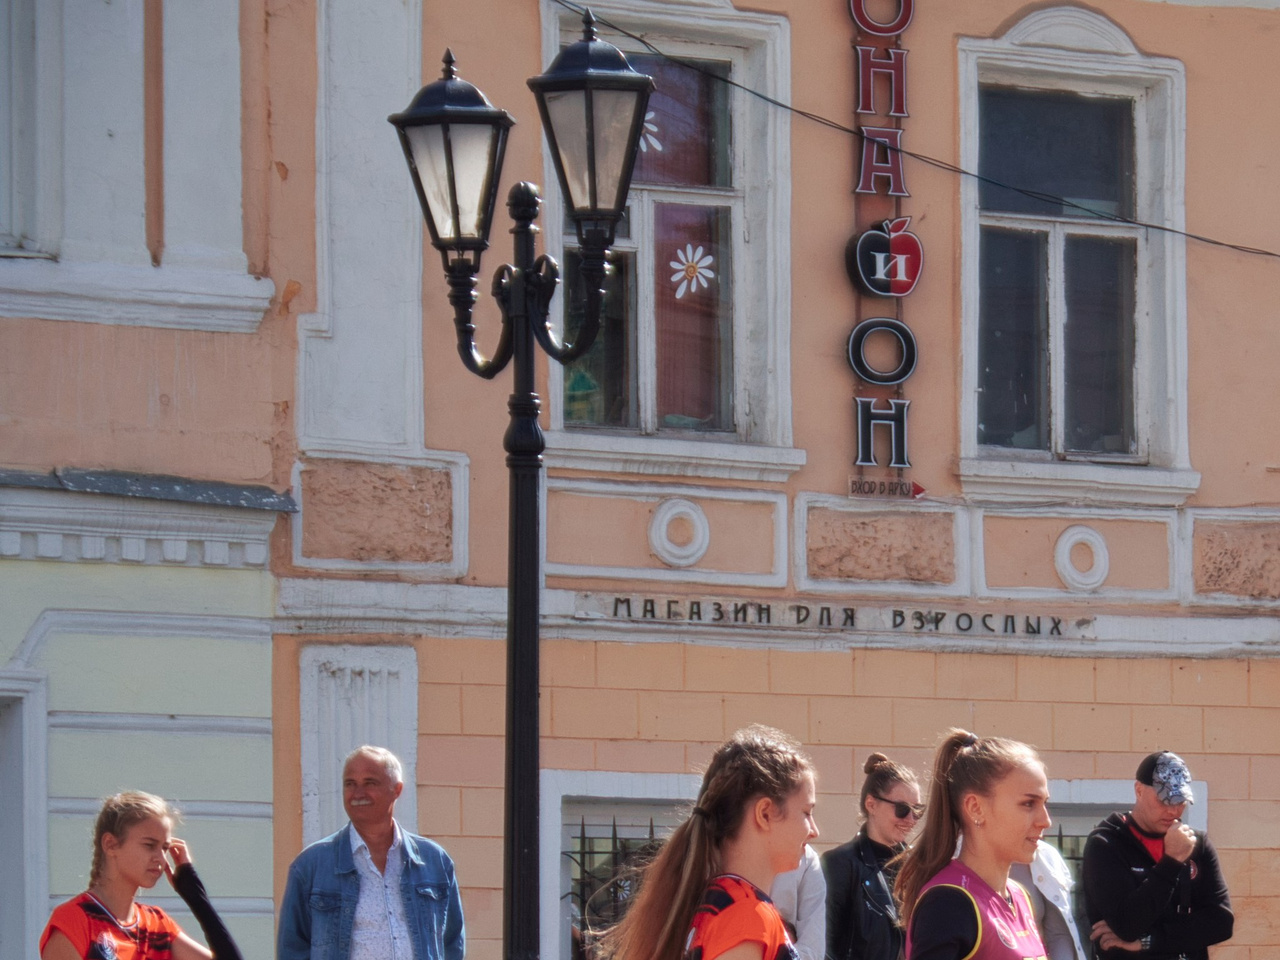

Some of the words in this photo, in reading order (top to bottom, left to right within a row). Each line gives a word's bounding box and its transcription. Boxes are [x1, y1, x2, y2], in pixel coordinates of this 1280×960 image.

[848, 317, 919, 468] ОН
[851, 480, 876, 494] ВХОД
[880, 481, 886, 494] В
[889, 482, 911, 496] АРКУ
[613, 597, 771, 624] МАГАЗИН
[795, 605, 855, 627] ДЛЯ
[892, 609, 1062, 636] ВЗРОСЛЫХ
